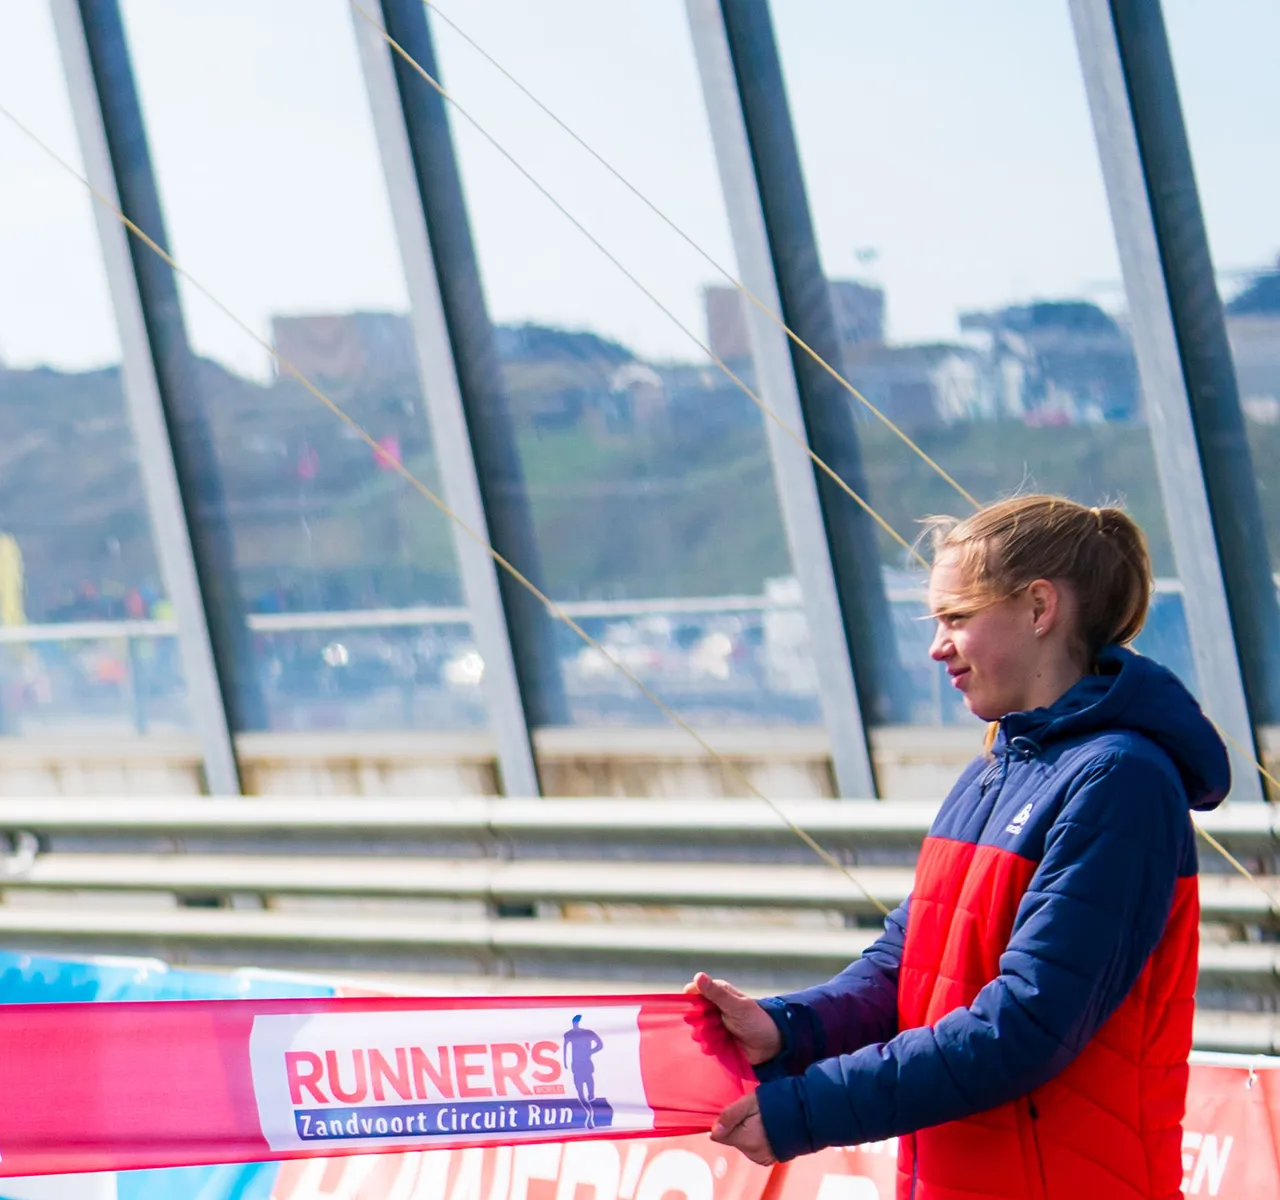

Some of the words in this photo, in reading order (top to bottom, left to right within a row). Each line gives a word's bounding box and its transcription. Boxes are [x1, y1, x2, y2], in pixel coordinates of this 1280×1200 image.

[284, 1041, 562, 1105] RUNNER'S
[299, 1110, 427, 1137] Zandvoort
[436, 1107, 517, 1132] Circuit
[527, 1104, 573, 1125] Run
